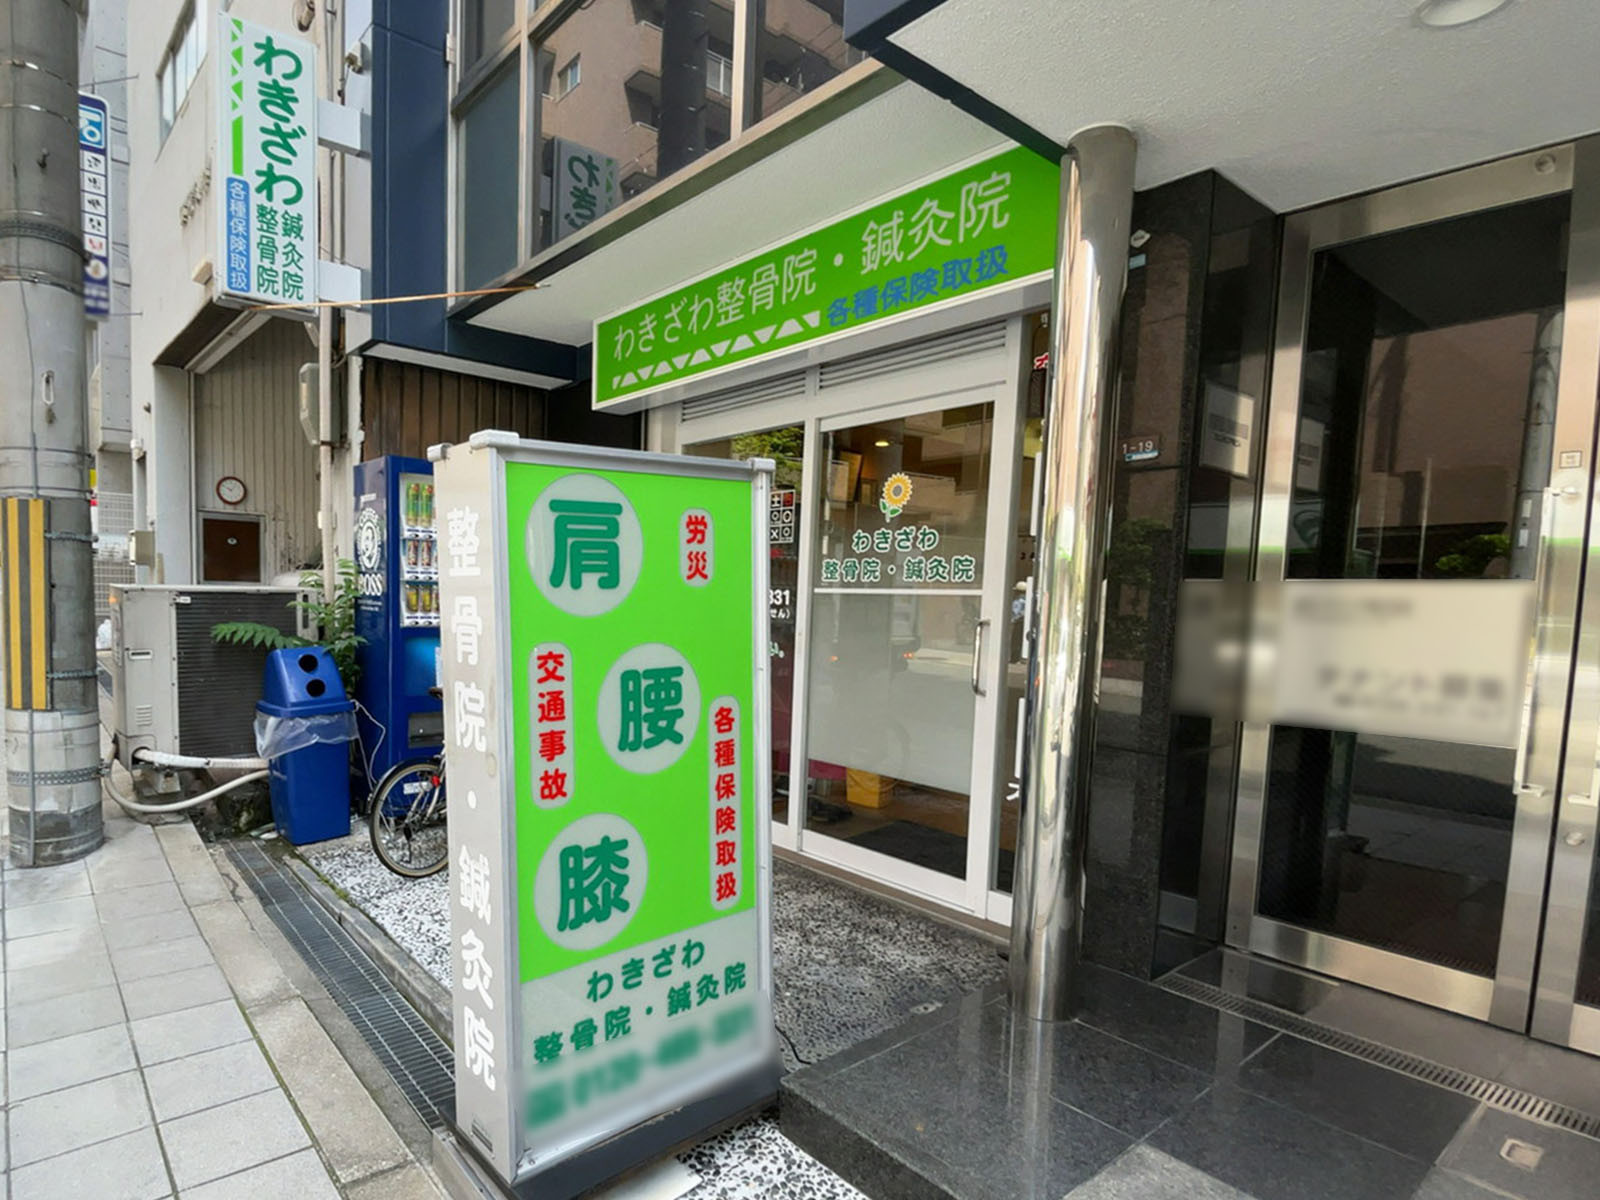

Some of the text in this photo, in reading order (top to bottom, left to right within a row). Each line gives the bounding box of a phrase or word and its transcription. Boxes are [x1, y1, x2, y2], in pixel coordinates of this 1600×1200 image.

[253, 35, 307, 206] わきざわ
[228, 181, 249, 290] 各種保険取扱
[255, 204, 279, 295] 整骨院
[281, 209, 304, 301] 鍼灸院
[613, 171, 1012, 361] わきざわ整骨院・鍼灸院
[826, 244, 1008, 327] 各種保険取扱
[1122, 440, 1154, 454] 1-19
[549, 499, 623, 590] 肩
[685, 515, 708, 580] 労災
[821, 556, 976, 582] 整骨院・鍼灸院
[851, 525, 939, 553] わきざわ
[536, 651, 567, 800] 交通事故
[618, 666, 684, 752] 腰
[446, 506, 496, 1091] 整骨院・鍼灸院
[714, 706, 737, 901] 各種保険取扱
[557, 835, 630, 932] 膝
[533, 962, 747, 1065] 整骨院・鍼灸院
[586, 939, 706, 1003] わきざわ
